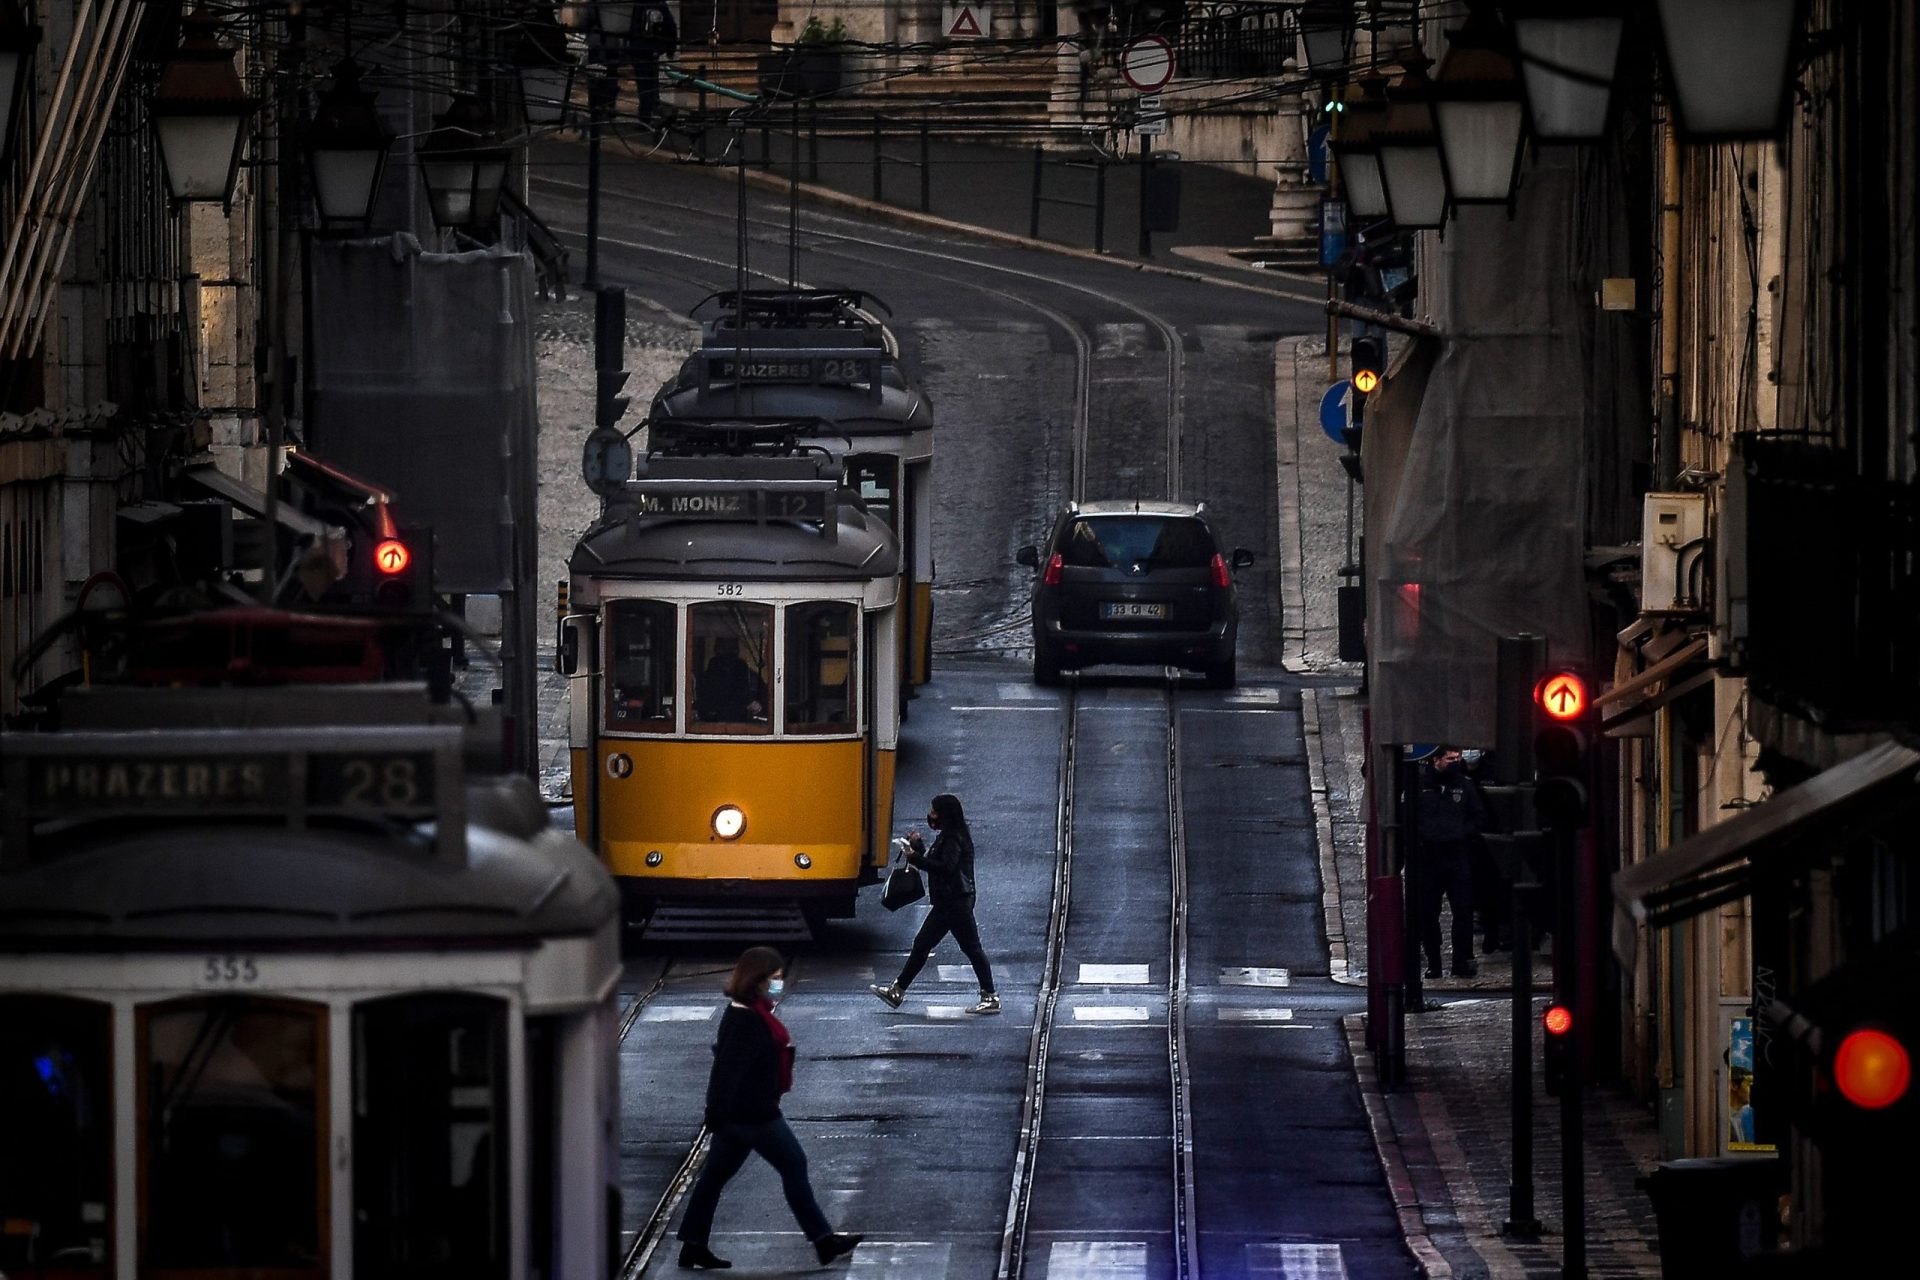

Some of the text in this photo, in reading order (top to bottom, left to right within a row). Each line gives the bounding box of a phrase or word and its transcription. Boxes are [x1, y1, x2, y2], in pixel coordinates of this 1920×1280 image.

[723, 362, 810, 378] PRAZERES
[825, 359, 857, 380] 28
[642, 496, 740, 513] M. MONIZ
[780, 495, 807, 517] 12
[717, 584, 743, 597] 582
[45, 761, 266, 799] PRAZERES
[341, 758, 419, 807] 28
[205, 955, 259, 982] 555
